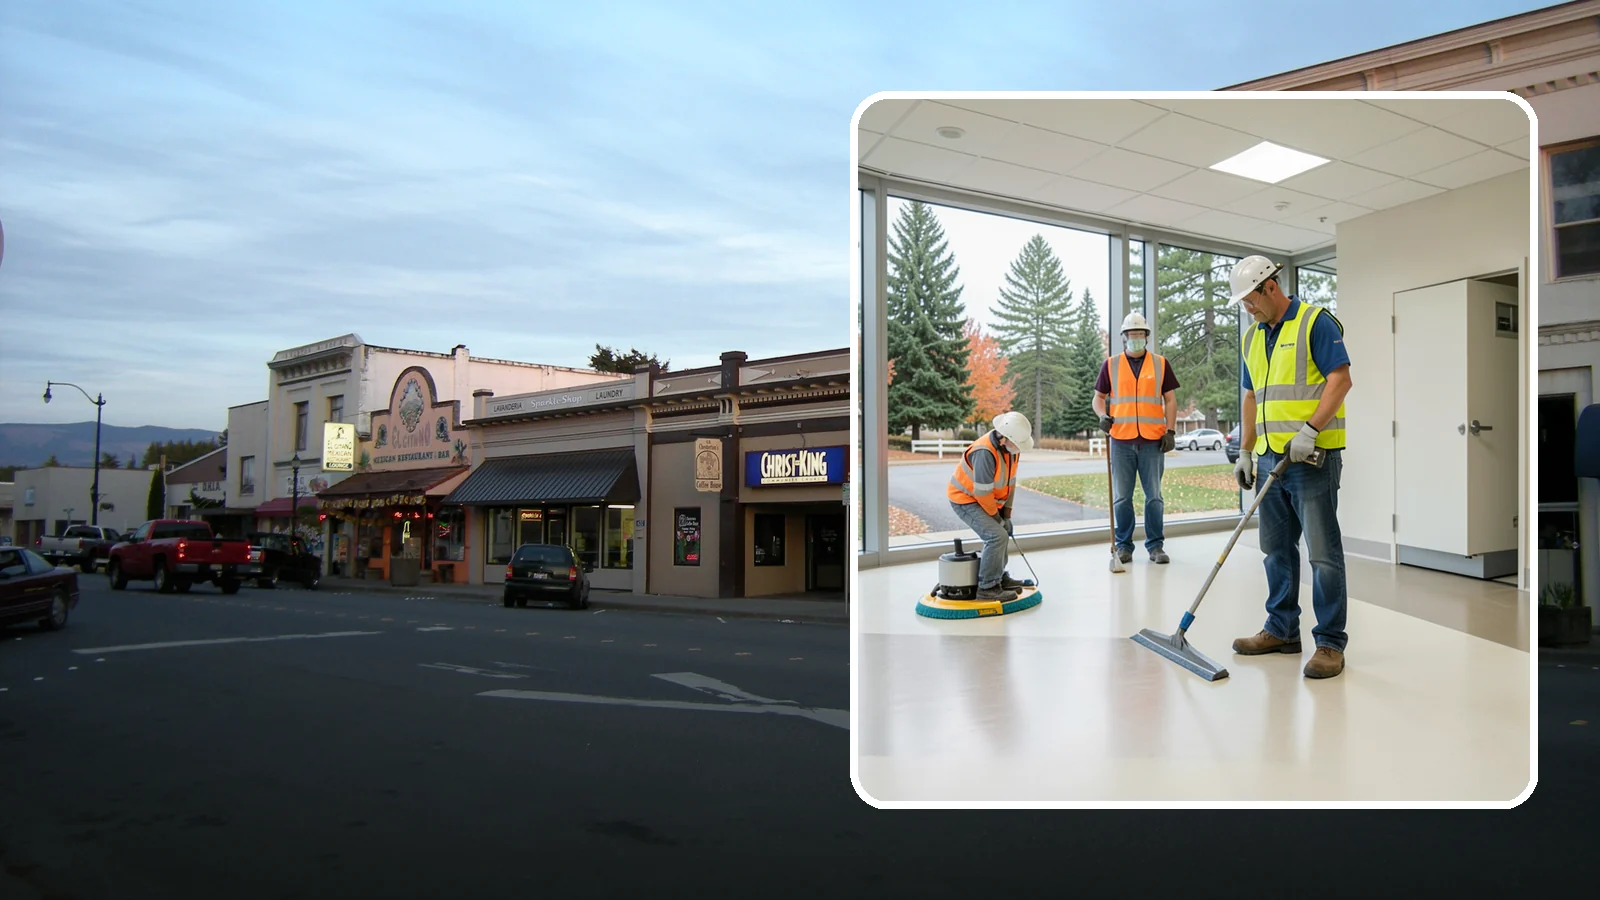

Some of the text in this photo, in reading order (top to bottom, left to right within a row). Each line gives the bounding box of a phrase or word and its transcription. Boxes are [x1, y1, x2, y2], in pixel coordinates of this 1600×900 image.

[595, 389, 623, 400] LAUNDRY
[493, 402, 522, 412] LAVANDERIA
[374, 455, 396, 464] MEXICAN
[398, 451, 433, 462] RESTAURANT
[438, 450, 450, 459] BAR
[761, 450, 827, 477] CHRIST KING
